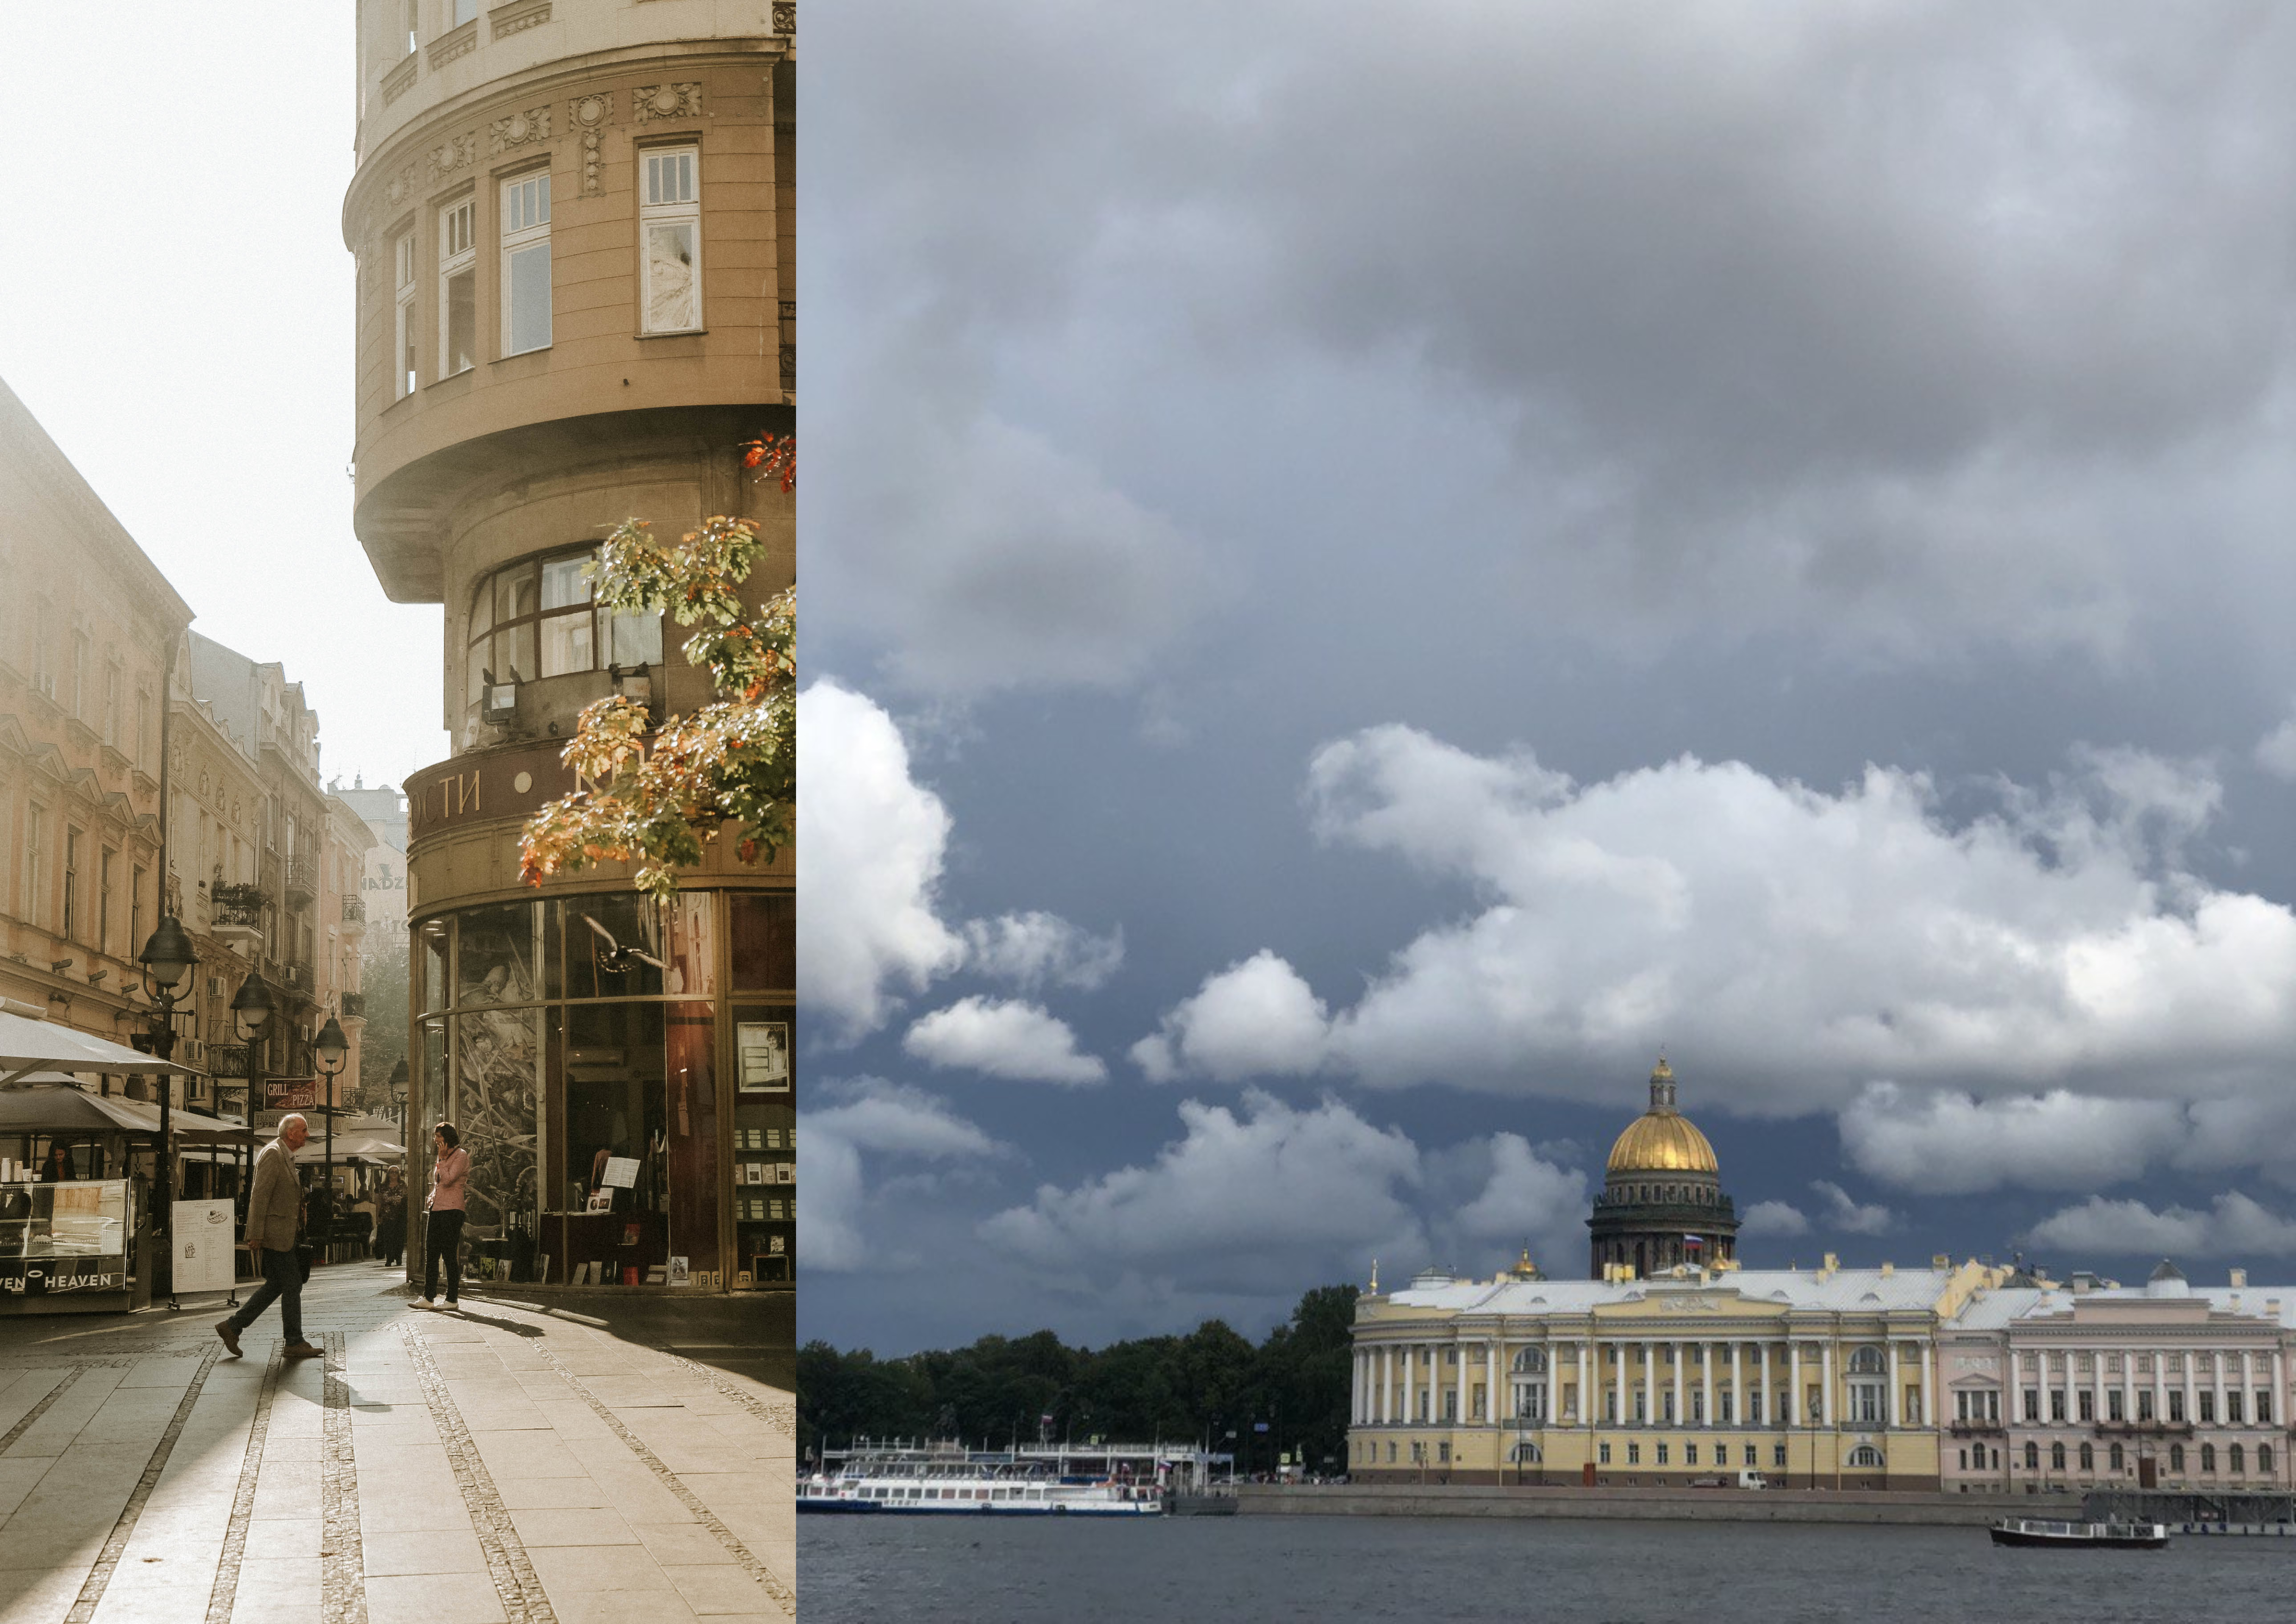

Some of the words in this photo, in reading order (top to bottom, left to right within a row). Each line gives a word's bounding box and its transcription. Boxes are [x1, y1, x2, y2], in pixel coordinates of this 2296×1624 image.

[268, 1083, 288, 1096] GRILL
[292, 1094, 314, 1106] PIZZA
[45, 1274, 111, 1288] HEAVEN
